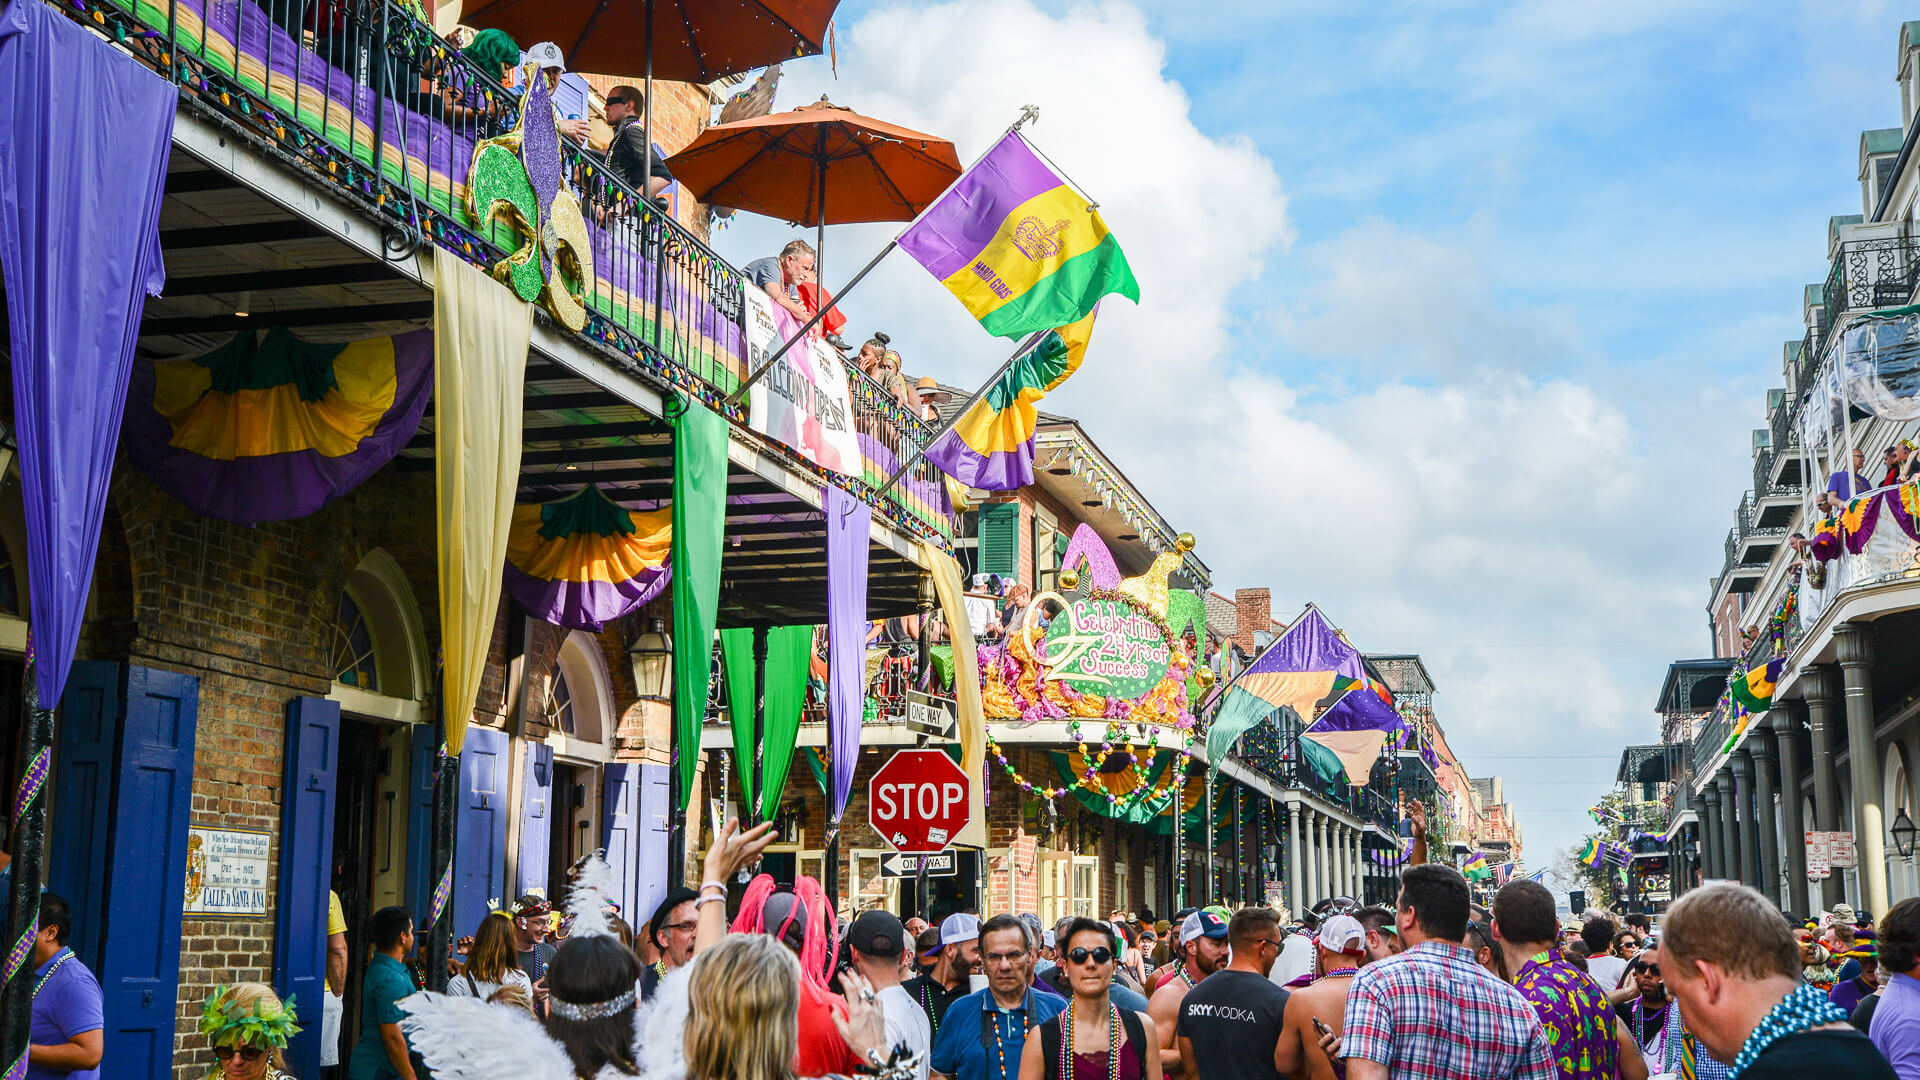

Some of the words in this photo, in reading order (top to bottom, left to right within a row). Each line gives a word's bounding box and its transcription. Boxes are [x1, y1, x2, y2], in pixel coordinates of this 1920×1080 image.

[971, 261, 997, 283] MARDI
[989, 278, 1013, 299] GRAS
[814, 385, 847, 433] OPEN
[1074, 601, 1160, 641] Celebrating
[1101, 634, 1125, 657] 24
[1080, 648, 1148, 678] Success
[911, 703, 925, 722] ONE
[927, 707, 942, 725] WAY
[877, 782, 964, 821] STOP
[902, 858, 917, 869] ON
[204, 886, 226, 907] CALLE
[231, 887, 250, 908] SANTA
[251, 889, 264, 908] ANA
[1187, 1003, 1213, 1017] SKYY
[1213, 1005, 1256, 1023] VODKA
